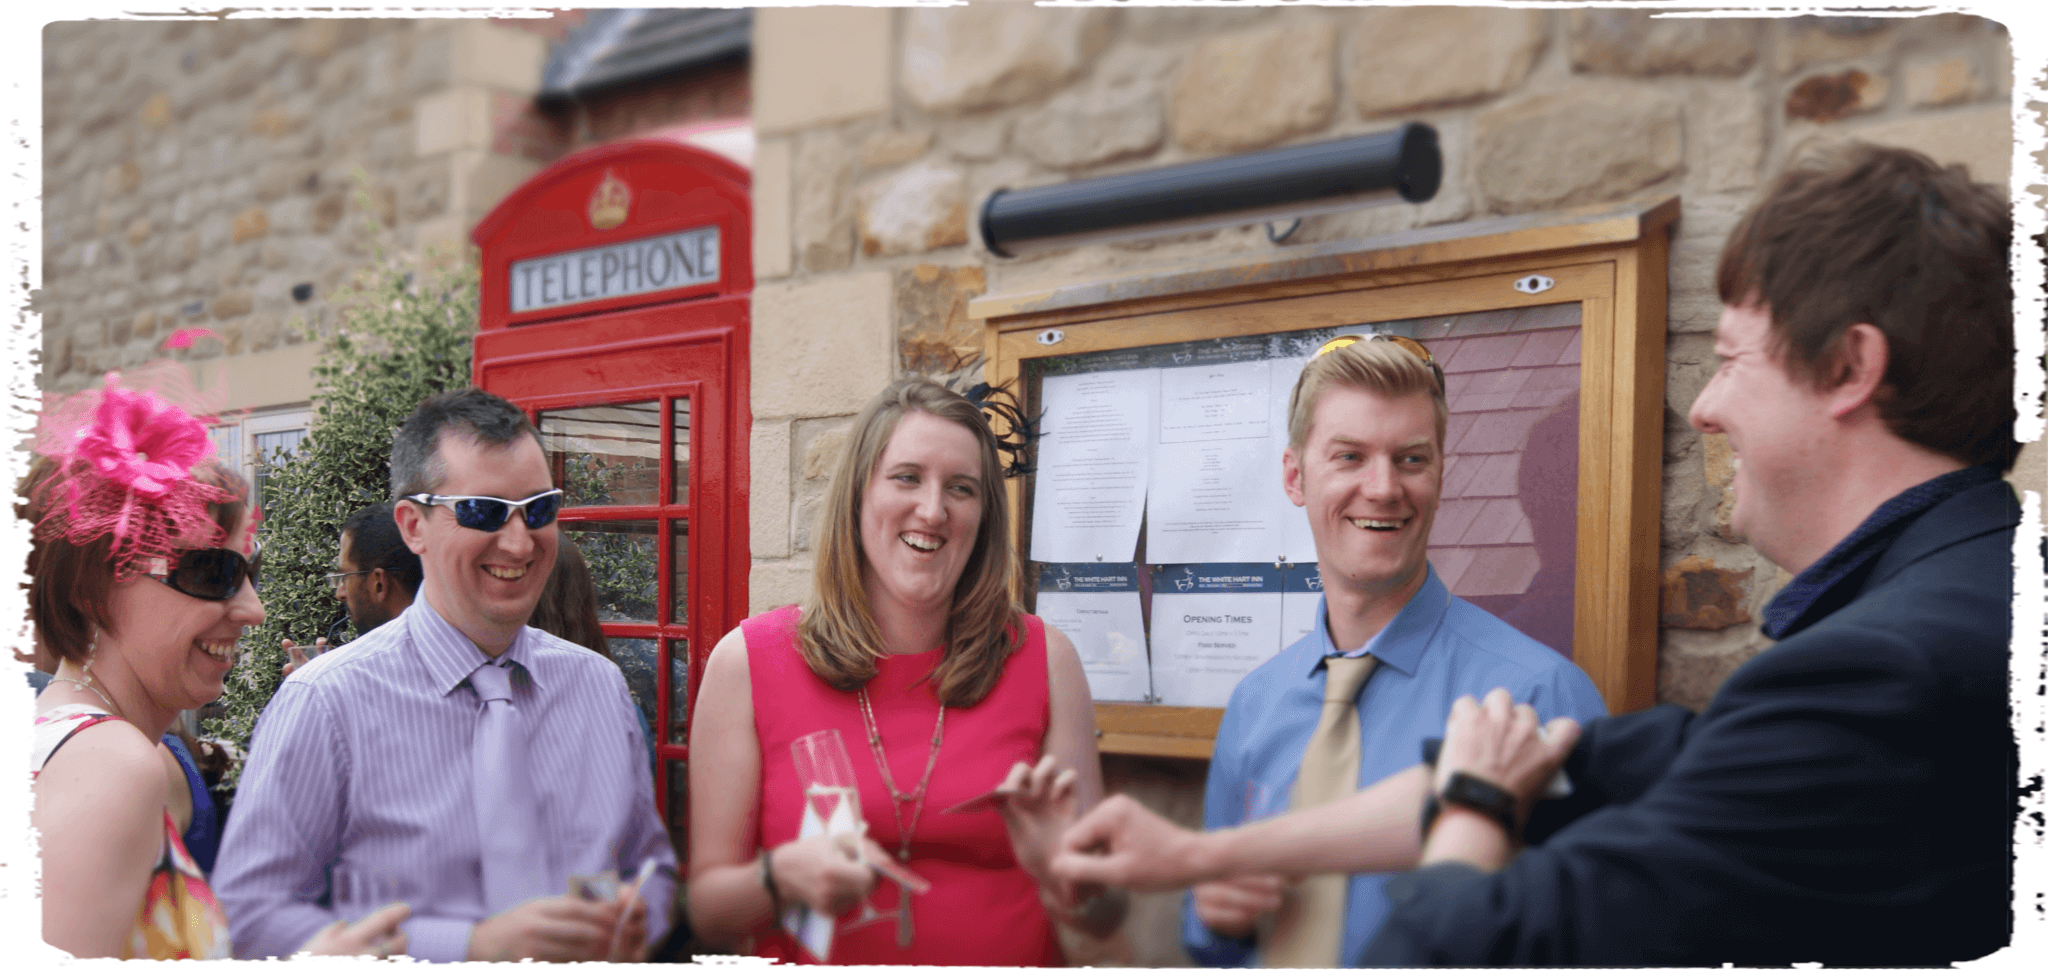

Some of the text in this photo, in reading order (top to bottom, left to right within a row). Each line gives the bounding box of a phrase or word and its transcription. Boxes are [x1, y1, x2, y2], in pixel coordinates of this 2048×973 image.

[521, 233, 717, 308] TELEPHONE
[1183, 614, 1253, 623] OPENING TIMES
